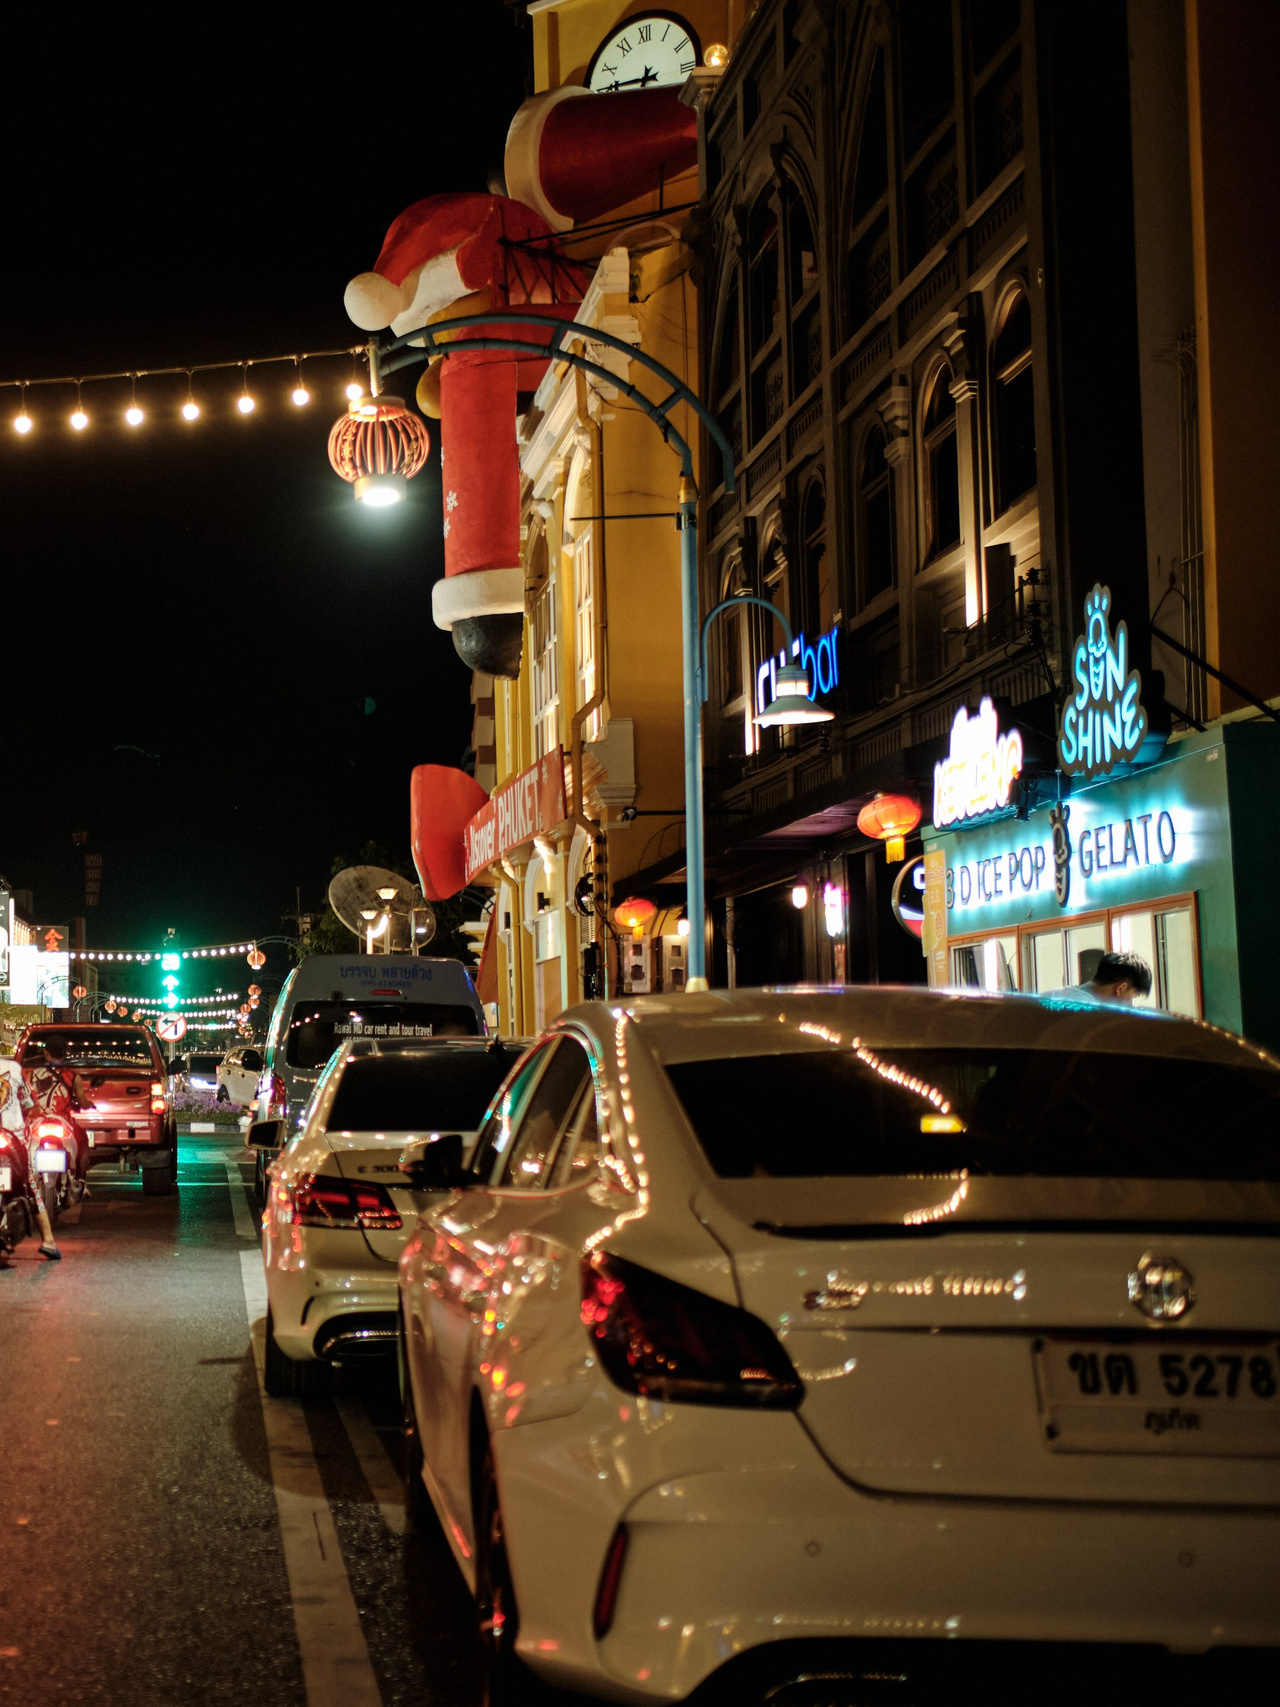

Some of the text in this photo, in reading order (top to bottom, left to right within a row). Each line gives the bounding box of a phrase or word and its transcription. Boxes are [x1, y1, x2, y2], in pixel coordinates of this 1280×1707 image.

[1074, 628, 1126, 711] SUN
[498, 766, 539, 854] PHUKET
[977, 854, 1003, 902] ICE
[1008, 845, 1046, 893] POP
[1078, 810, 1176, 879] GELATO
[364, 1025, 374, 1035] car
[374, 1023, 387, 1035] rent
[388, 1022, 400, 1035] and
[401, 1024, 414, 1036] tour
[415, 1023, 433, 1036] travel
[1158, 1354, 1277, 1399] 5278
